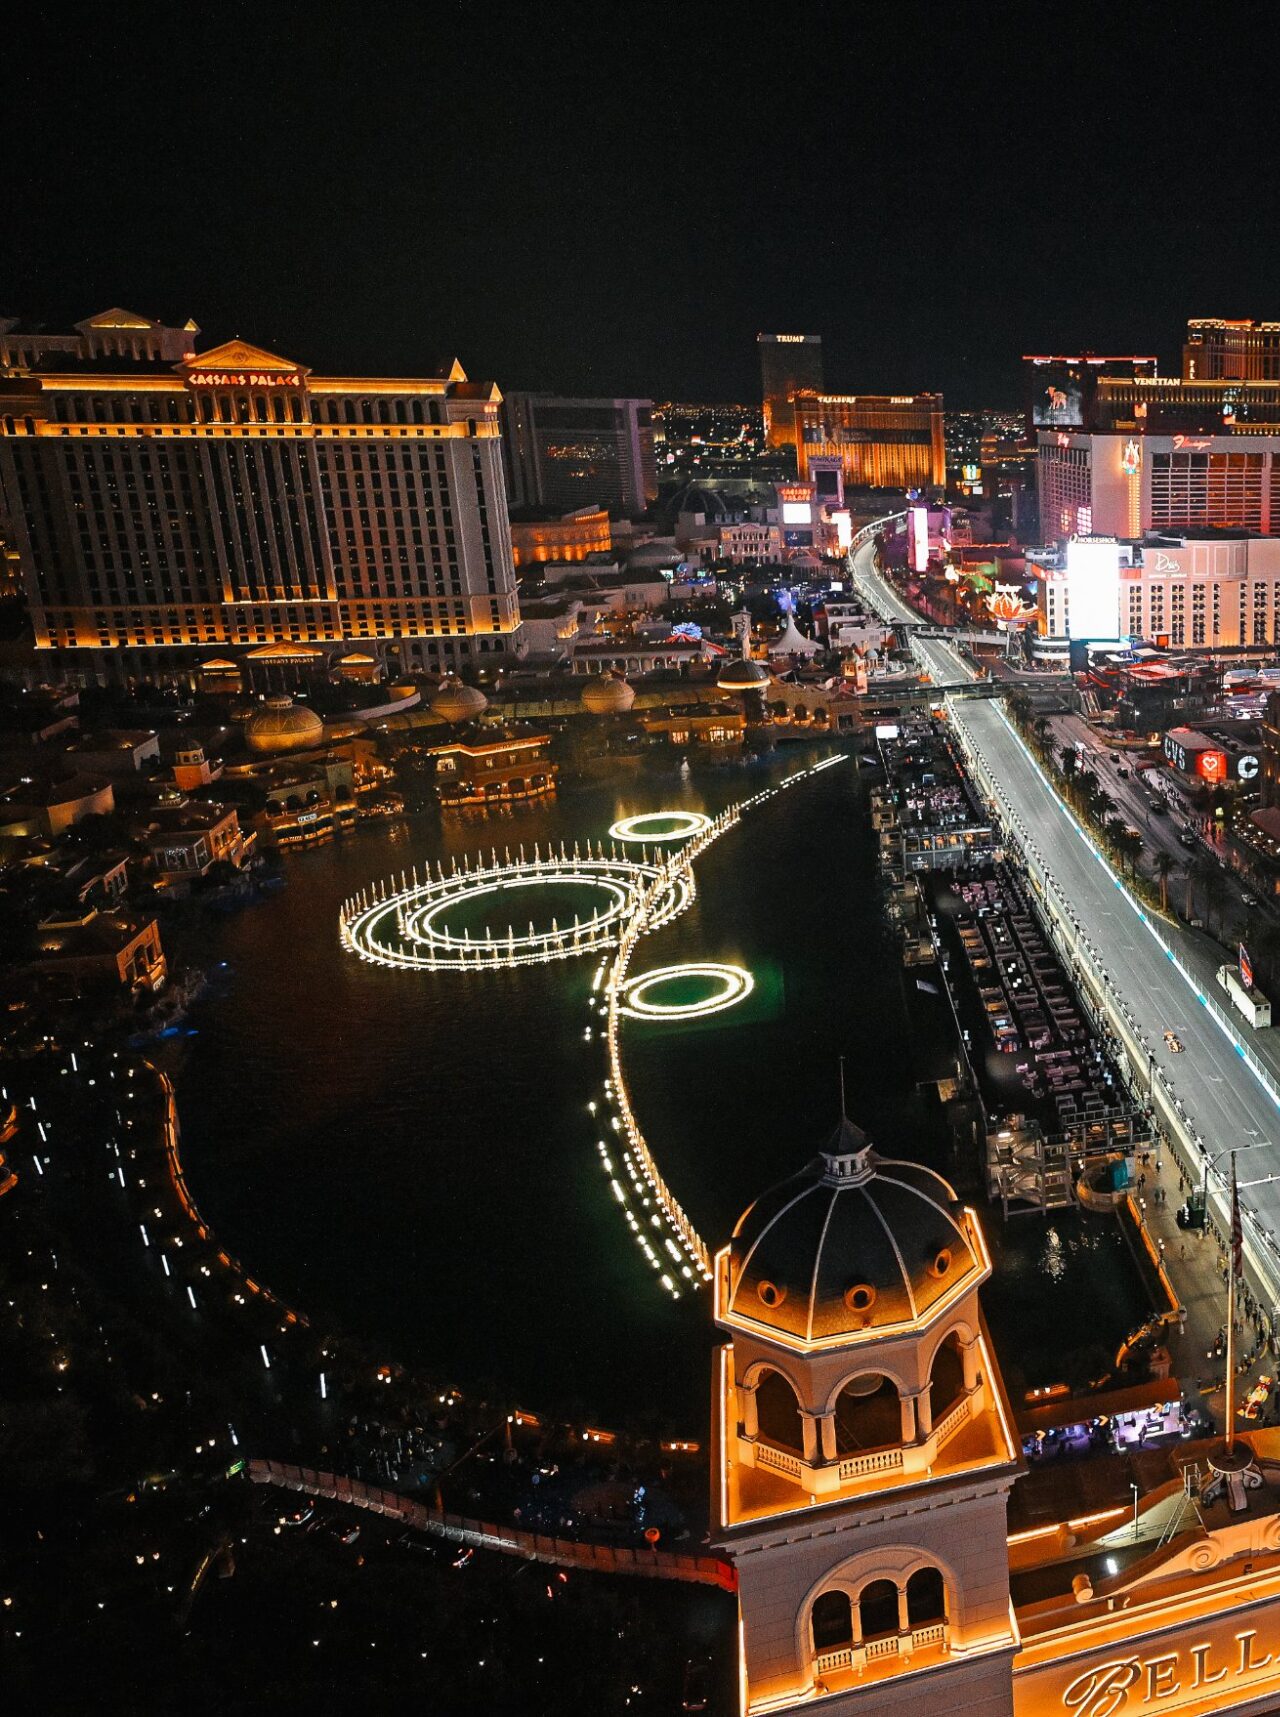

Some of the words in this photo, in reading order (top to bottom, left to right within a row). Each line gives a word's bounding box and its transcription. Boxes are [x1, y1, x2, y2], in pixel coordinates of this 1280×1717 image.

[776, 335, 805, 343] TRUMP
[188, 374, 246, 386] CAESARS
[249, 375, 300, 387] PALACE
[1133, 377, 1181, 387] VENETIAN
[1164, 737, 1185, 770] CVS
